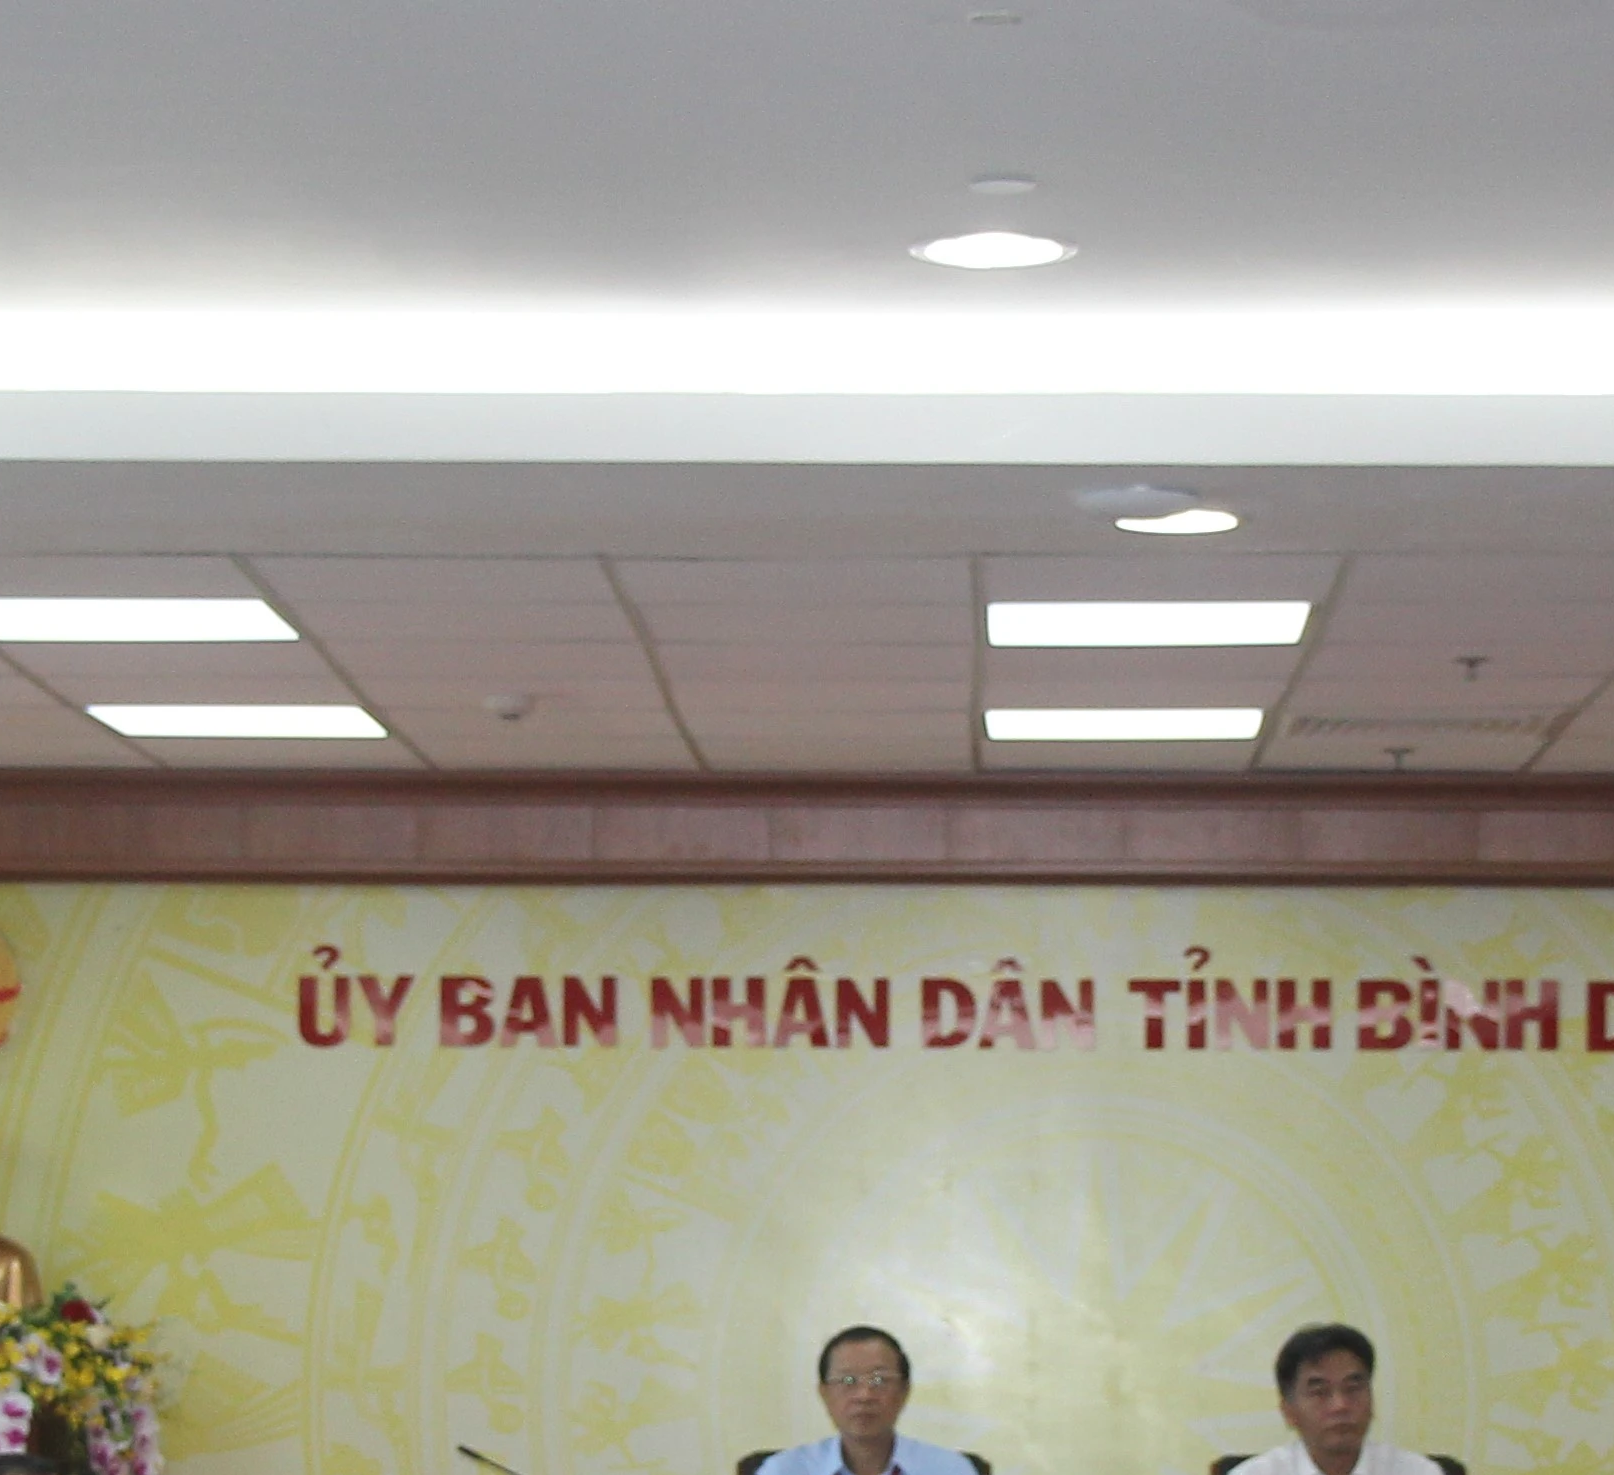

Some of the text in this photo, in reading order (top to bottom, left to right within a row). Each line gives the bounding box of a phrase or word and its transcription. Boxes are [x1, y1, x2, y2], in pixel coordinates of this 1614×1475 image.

[296, 945, 413, 1048] ỦY
[438, 975, 618, 1048] BAN
[648, 956, 890, 1048] NHÂN
[920, 957, 1097, 1051] DÂN
[1128, 946, 1332, 1051] TỈNH
[1356, 956, 1560, 1052] BÌNH
